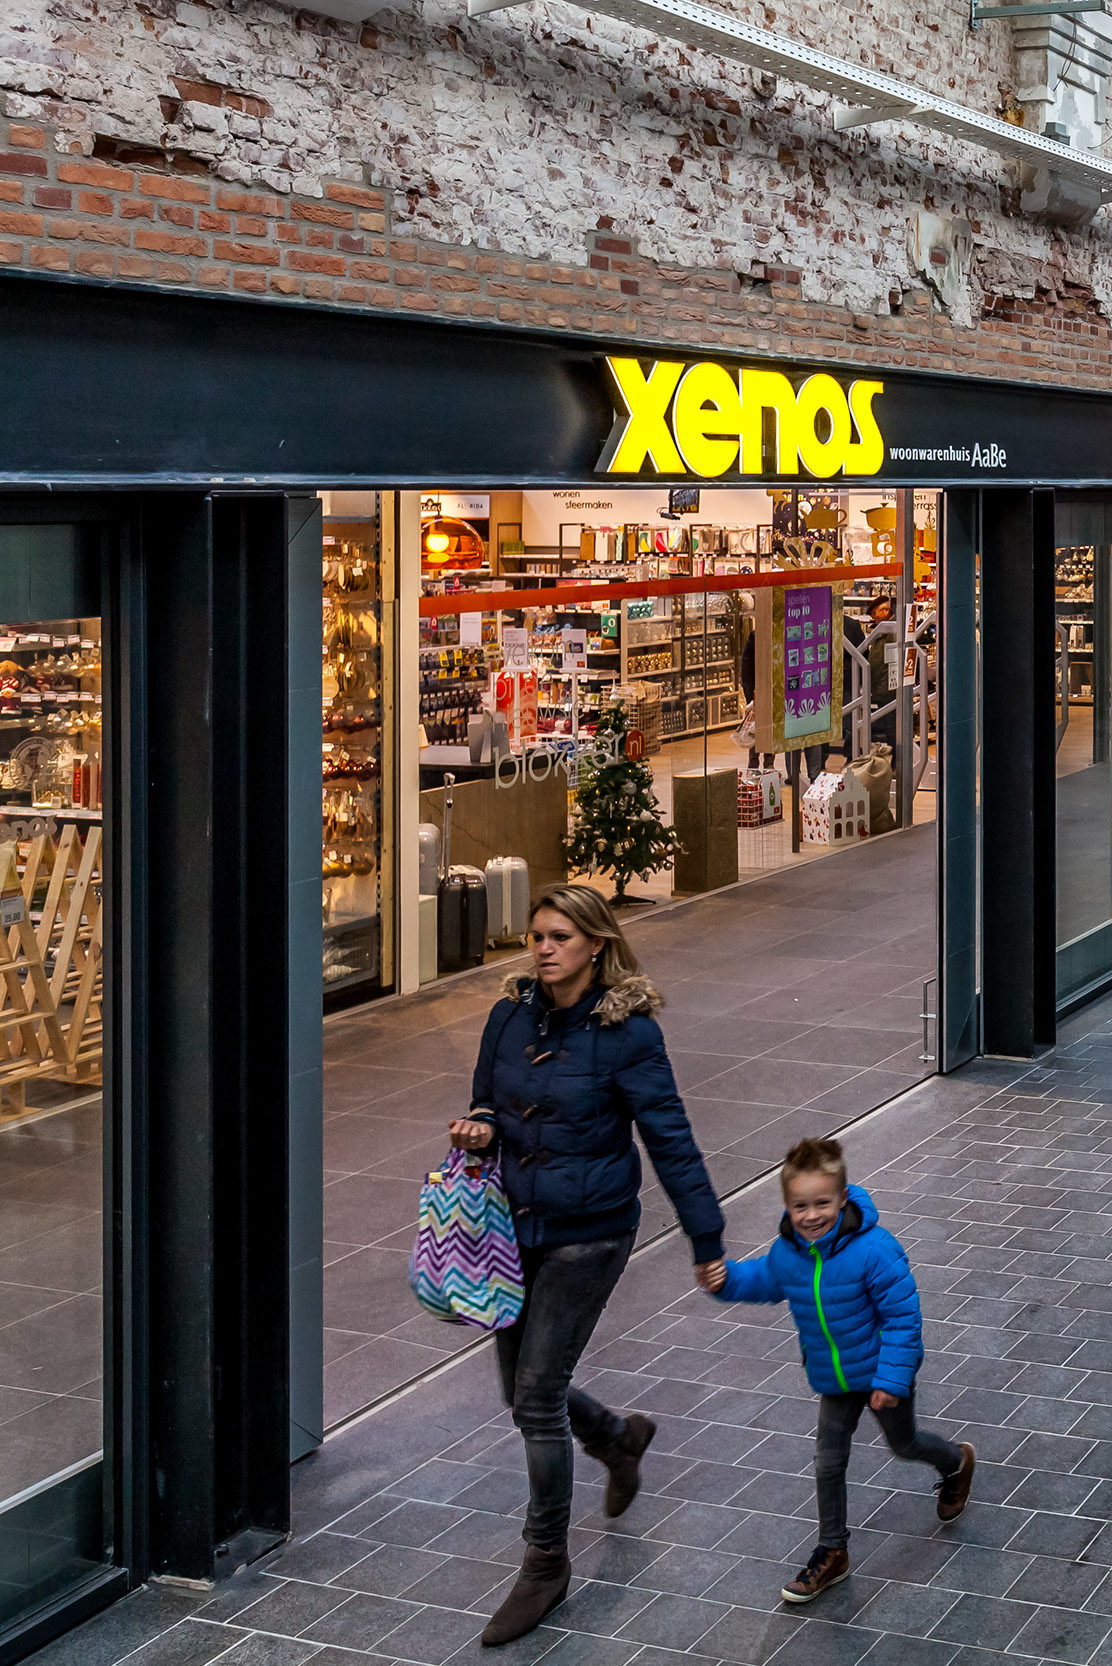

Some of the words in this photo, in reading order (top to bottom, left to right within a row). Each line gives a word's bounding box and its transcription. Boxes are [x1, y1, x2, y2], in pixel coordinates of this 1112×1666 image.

[606, 356, 885, 478] xenos
[889, 445, 970, 462] woonwarenhuis
[971, 442, 1007, 468] AaBe
[552, 491, 581, 499] wonen
[565, 500, 613, 510] sfeermaken
[788, 608, 801, 619] top
